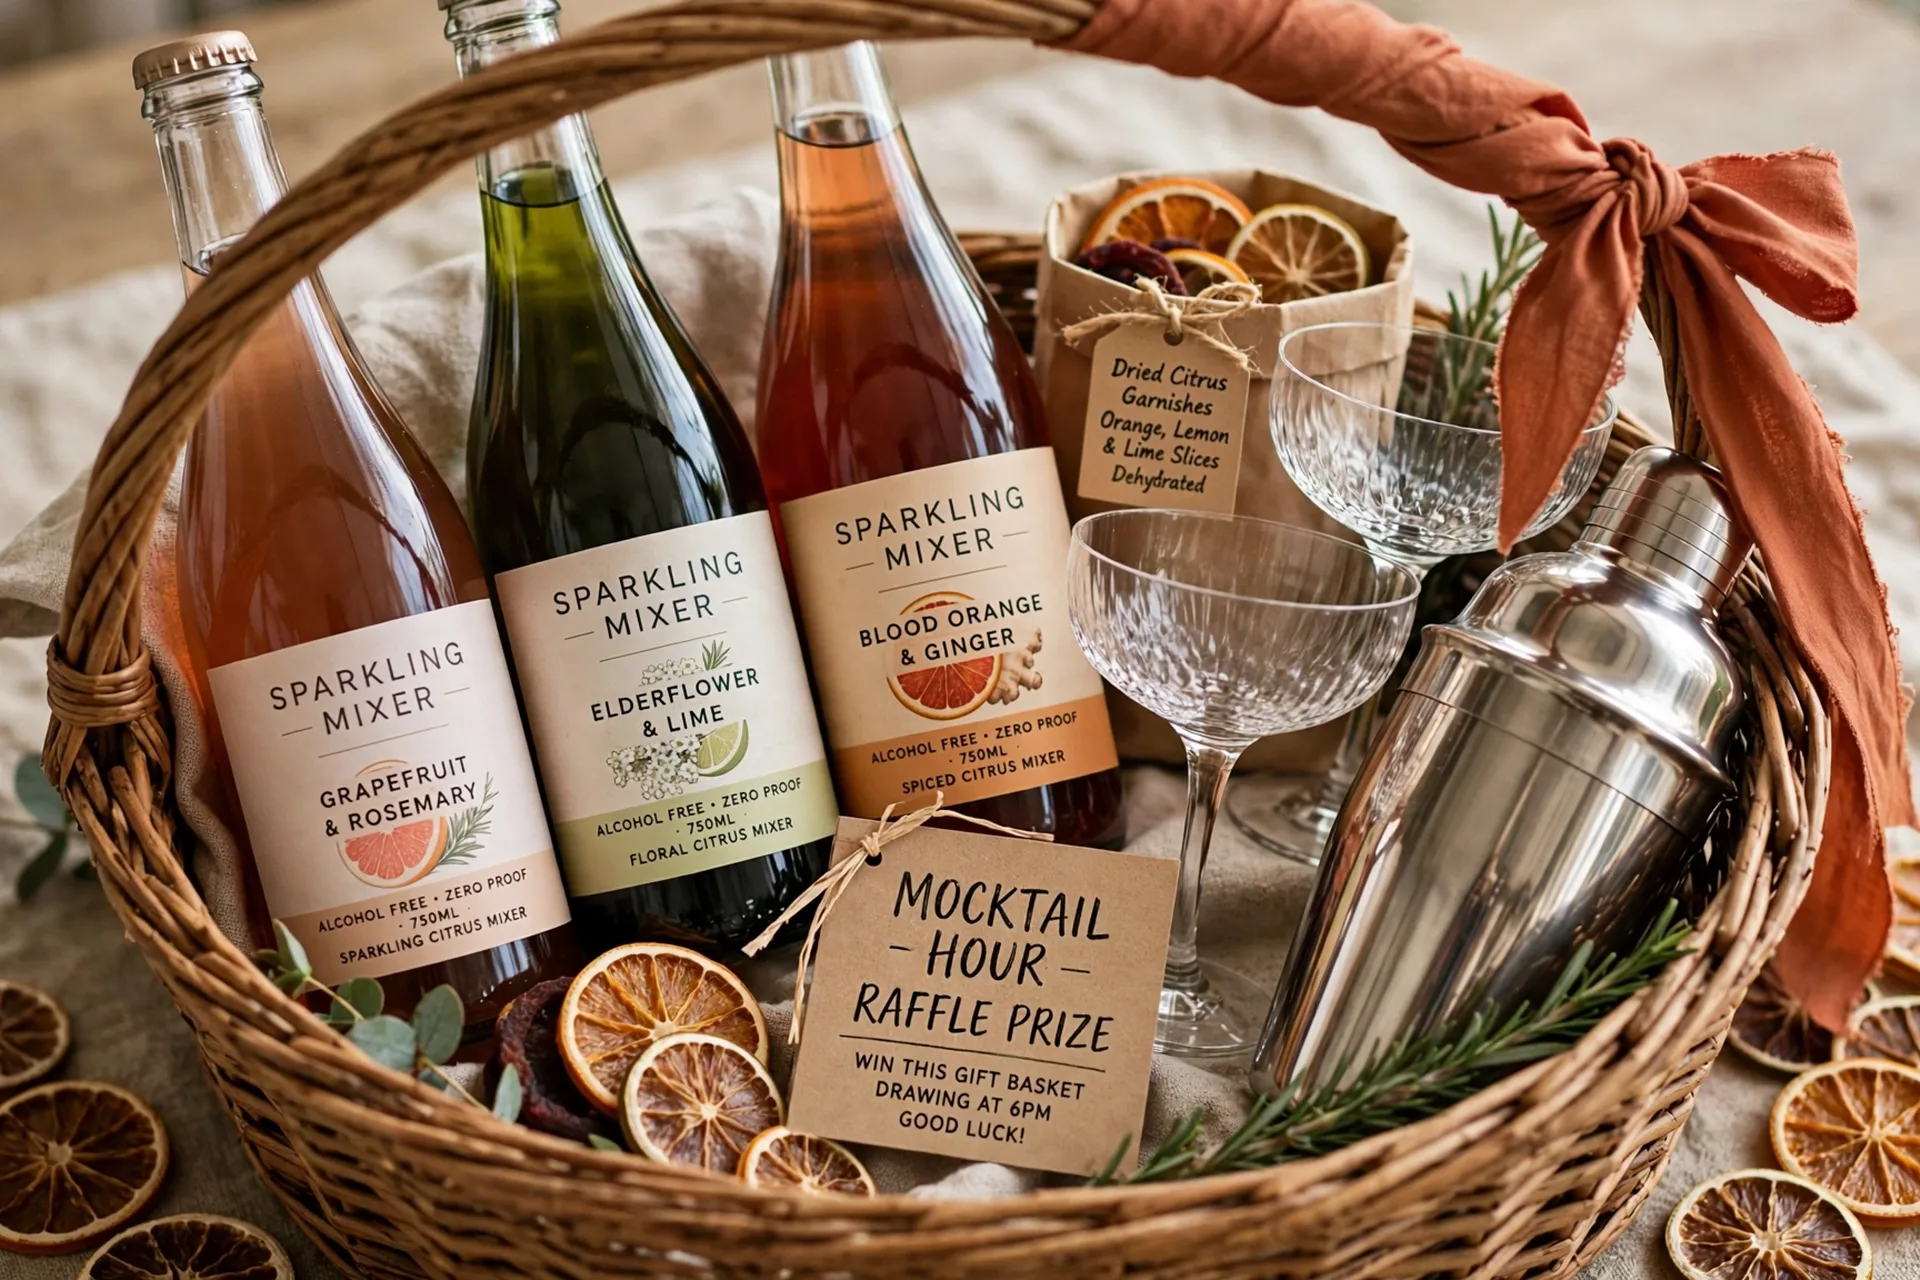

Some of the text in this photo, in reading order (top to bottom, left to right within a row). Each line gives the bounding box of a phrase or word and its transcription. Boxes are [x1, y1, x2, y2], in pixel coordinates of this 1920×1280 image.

[1112, 358, 1228, 391] Dried Citrus
[1122, 386, 1213, 416] Garnishes
[1101, 410, 1229, 444] Orange, Lemon
[1103, 437, 1220, 469] & Lime Slices
[1112, 465, 1207, 493] Dehydrated
[835, 486, 1024, 545] SPARKLING
[885, 528, 994, 570] MIXER
[553, 551, 743, 615] SPARKLING
[605, 594, 714, 639] MIXER
[859, 594, 1043, 647] BLOOD ORANGE
[901, 628, 1015, 666] & GINGER
[270, 642, 464, 710] SPARKLING
[591, 668, 759, 722] ELDERFLOWER
[323, 687, 434, 735] MIXER
[643, 705, 724, 738] & LIME
[872, 711, 1078, 764] ALCOHOL FREE ZERO PROOF
[960, 745, 1008, 764] 750ML
[320, 756, 467, 808] GRAPEFRUIT
[902, 750, 1066, 794] SPICED CITRUS MIXER
[325, 782, 477, 837] & ROSEMARY
[597, 778, 802, 837] ALCOHOL FREE ZERO PROOF
[687, 814, 736, 834] 750ML
[630, 817, 793, 866] FLORAL CITRUS MIXER
[318, 868, 528, 933] ALCOHOL FREE ZERO PROOF
[410, 908, 459, 930] 750ML
[894, 871, 1109, 940] MOCKTAIL
[339, 907, 527, 964] SPARKLING CITRUS MIXER
[927, 930, 1046, 986] HOUR
[853, 983, 1114, 1052] RAFFLE PRIZE
[855, 1052, 1085, 1100] WIN THIS GIFT BASKET
[876, 1081, 1051, 1121] DRAWING AT 6PM
[899, 1111, 1025, 1144] GOOD LUCK!
